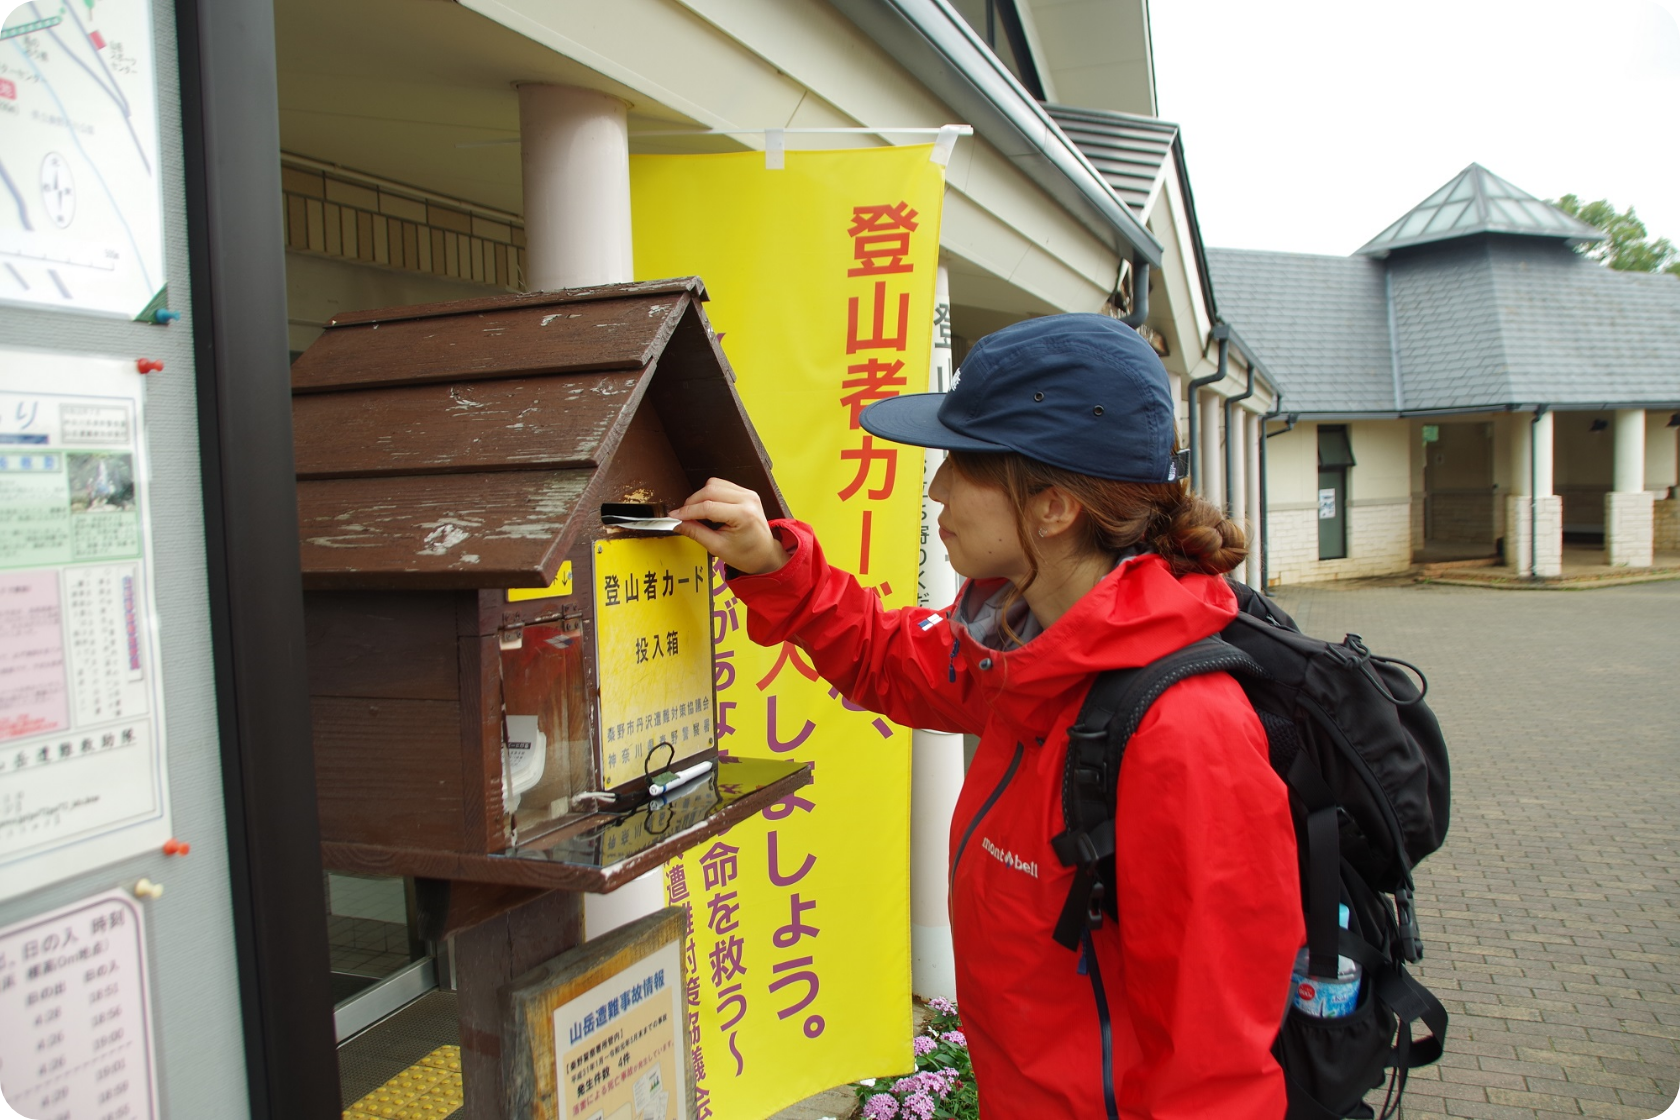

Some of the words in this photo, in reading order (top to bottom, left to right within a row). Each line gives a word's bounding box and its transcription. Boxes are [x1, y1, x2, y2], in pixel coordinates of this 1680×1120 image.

[604, 565, 705, 607] 登山者カード
[635, 630, 680, 664] 投入箱
[606, 695, 710, 744] 秦野市丹沢遭難対策協議会
[982, 836, 1005, 863] mont
[1014, 853, 1039, 879] bell
[569, 968, 665, 1046] 山岳遭難事故情報
[577, 1066, 610, 1099] 発生件数
[618, 1050, 631, 1068] 4件
